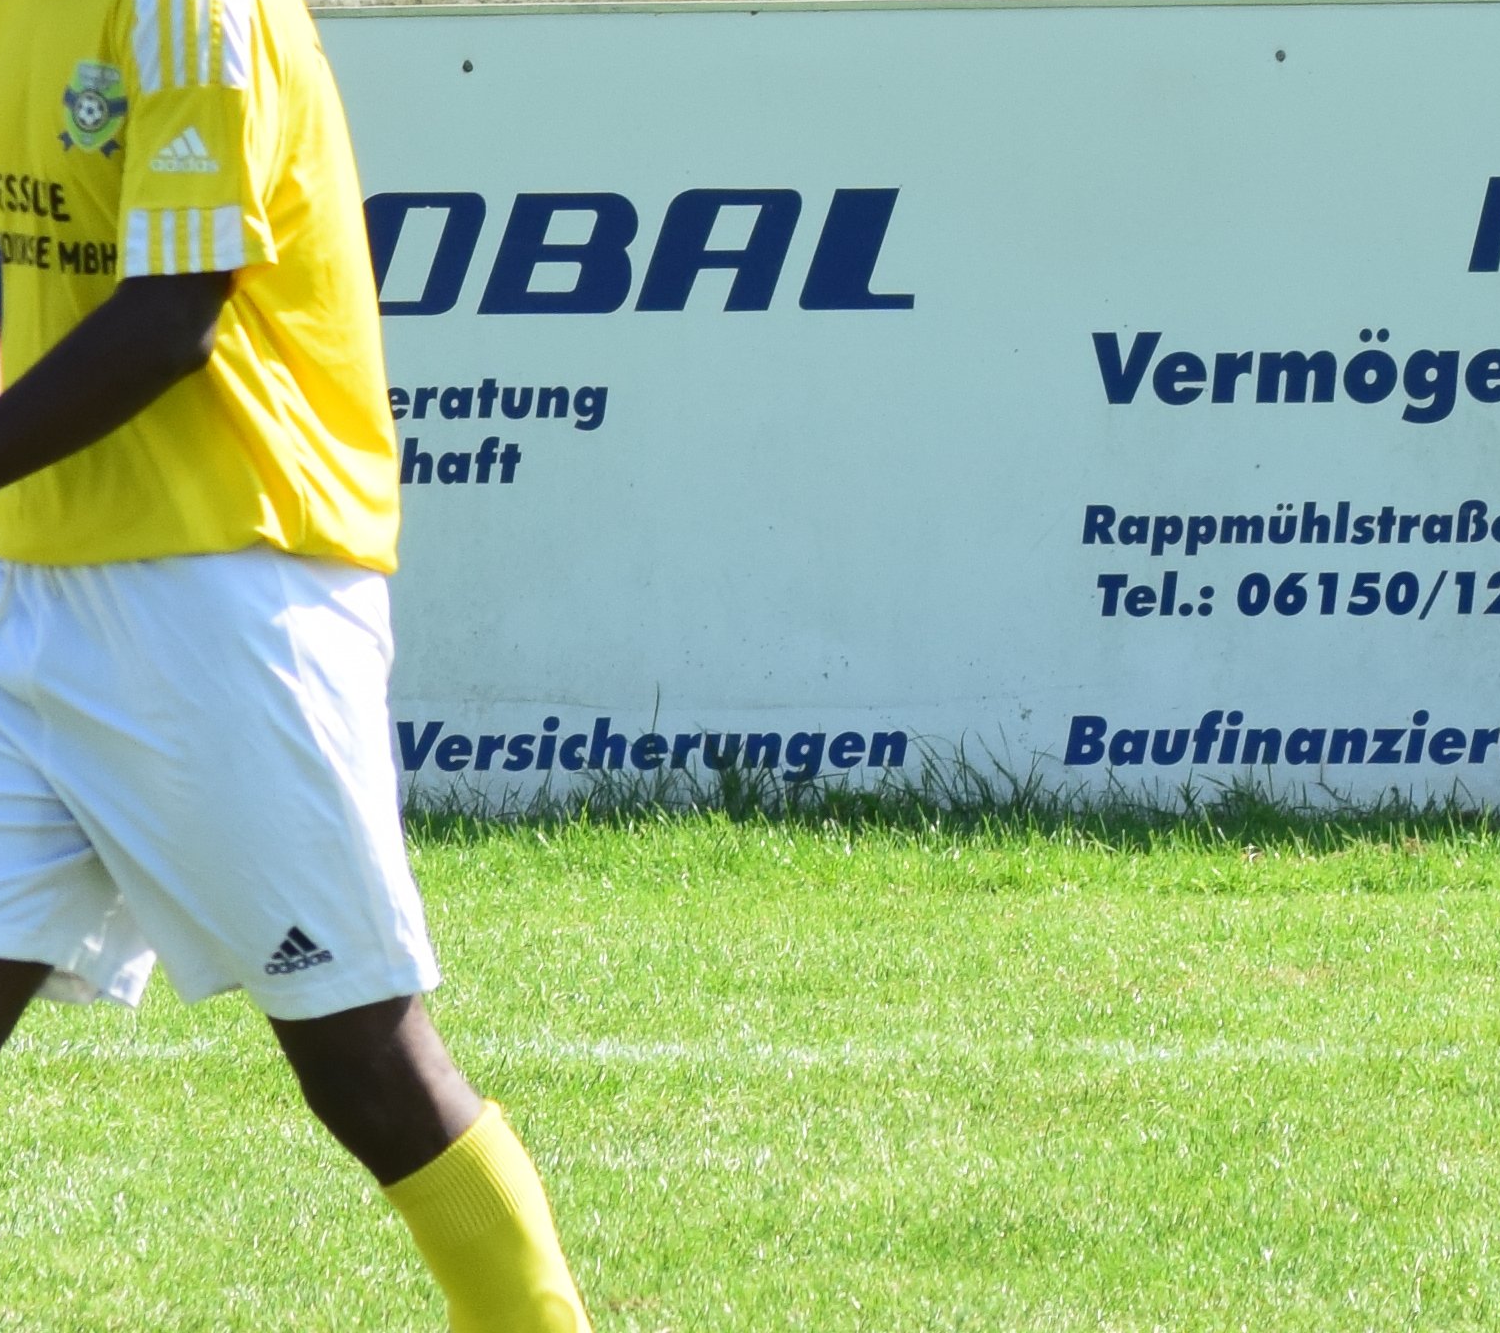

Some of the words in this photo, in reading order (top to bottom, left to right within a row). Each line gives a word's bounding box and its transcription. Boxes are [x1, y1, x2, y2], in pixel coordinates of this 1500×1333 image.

[1097, 573, 1214, 617] Tel.:
[396, 715, 908, 781] Versicherungen
[263, 949, 333, 976] adidas
